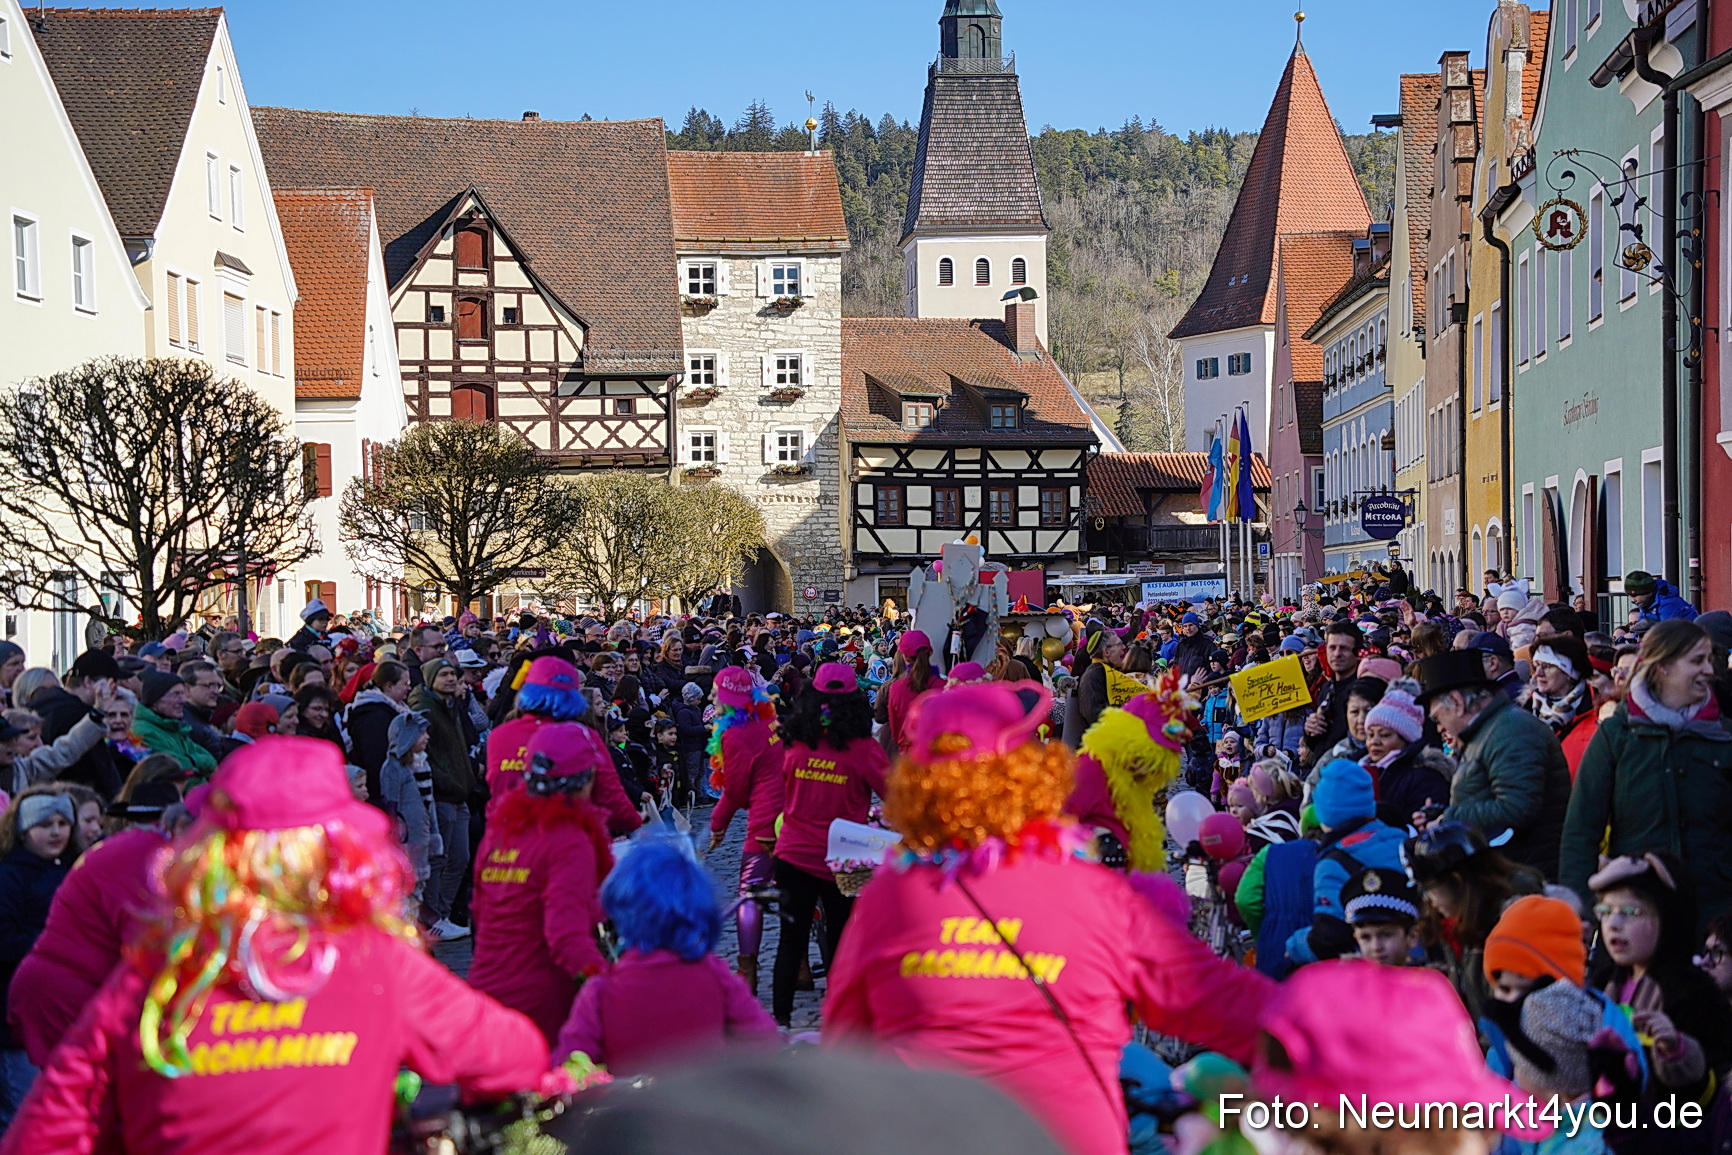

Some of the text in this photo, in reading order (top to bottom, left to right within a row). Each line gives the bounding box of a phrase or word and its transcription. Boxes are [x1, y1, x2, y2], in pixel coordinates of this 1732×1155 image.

[1365, 512, 1402, 521] METEORA
[1147, 581, 1187, 589] RESTAURANT
[807, 757, 836, 770] TEAM
[939, 916, 1023, 945] TEAM
[210, 997, 307, 1036] TEAM
